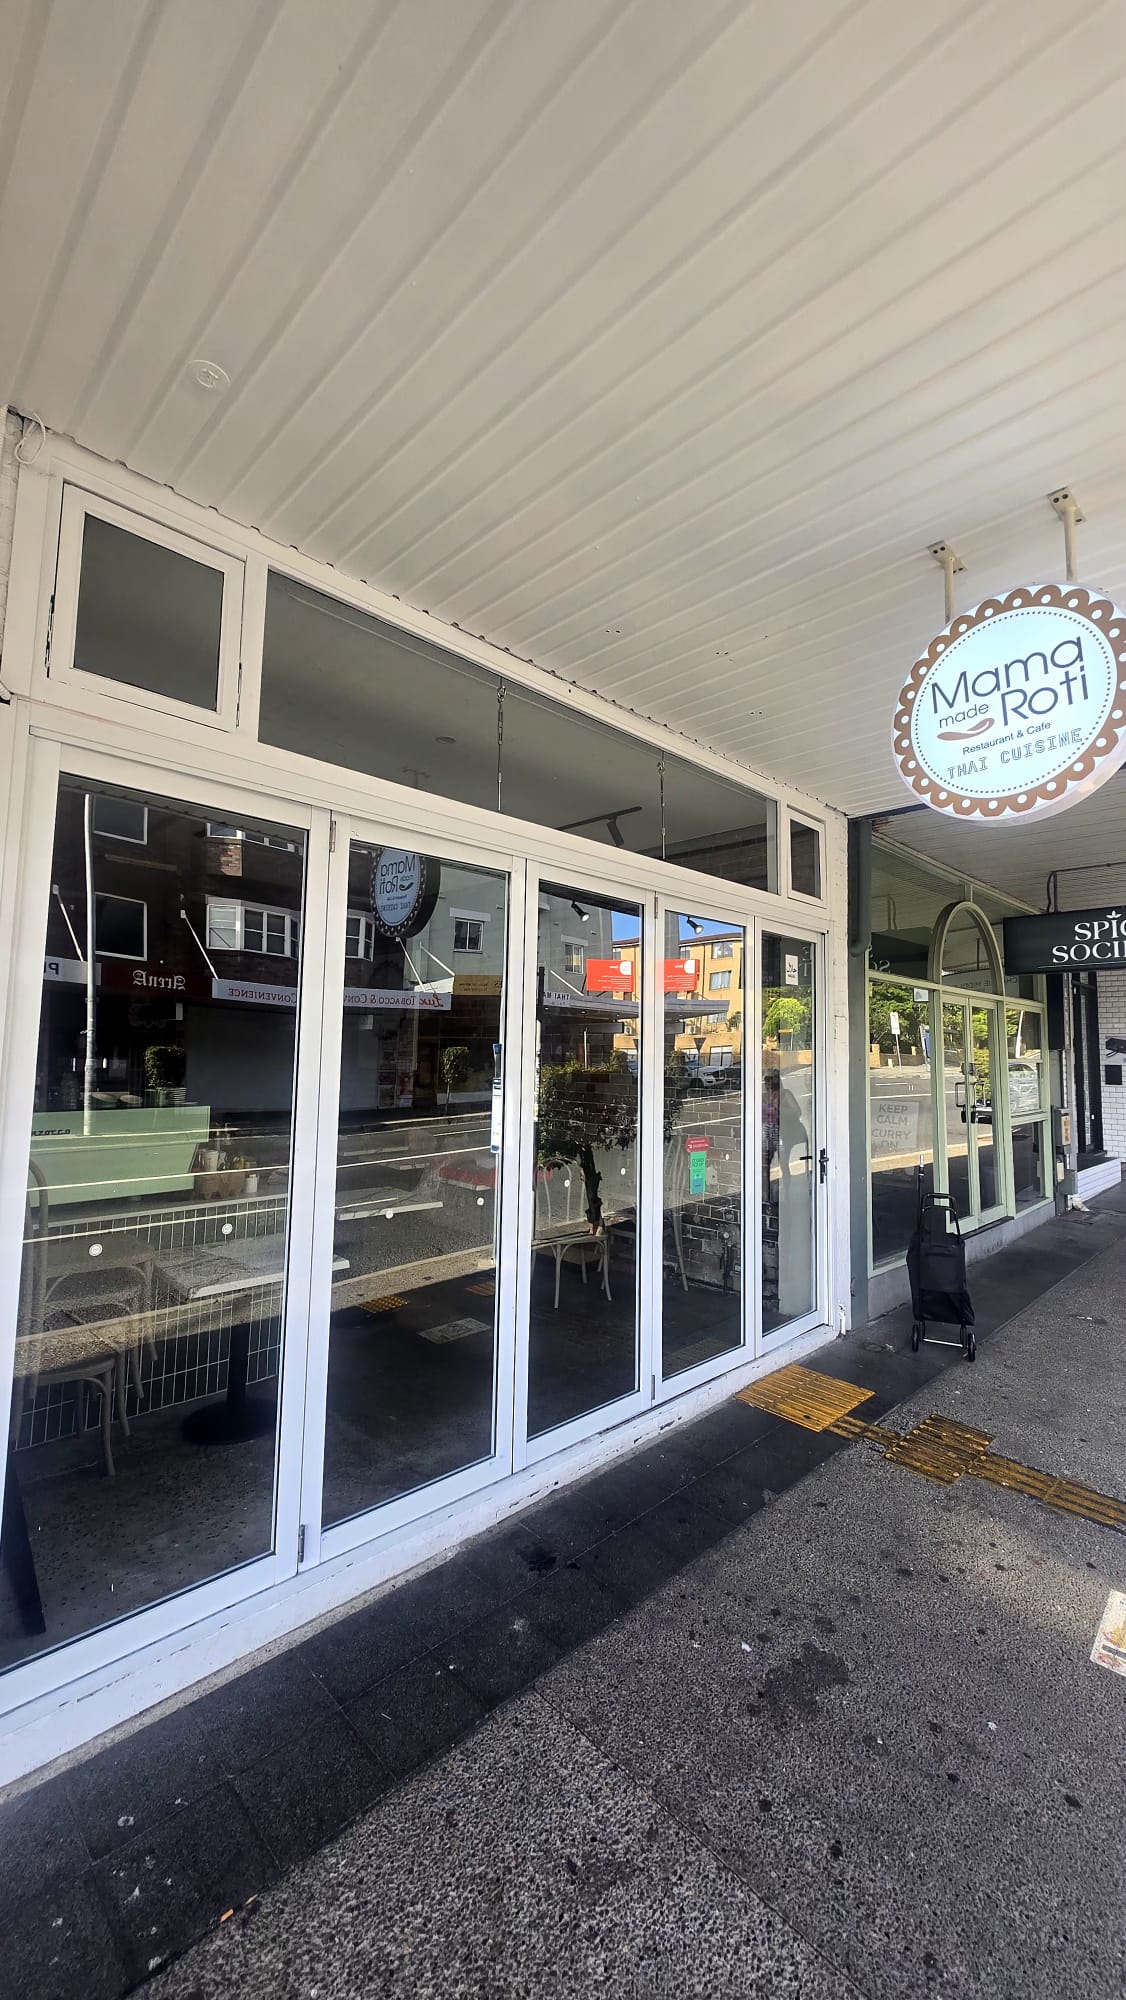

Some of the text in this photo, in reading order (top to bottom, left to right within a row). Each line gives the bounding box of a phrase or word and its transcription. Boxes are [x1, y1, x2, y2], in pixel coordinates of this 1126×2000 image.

[931, 636, 1082, 714] Mama
[939, 665, 1088, 728] made Roti
[947, 727, 1083, 779] THAI CUISINE
[962, 721, 1051, 755] Restaurant & Cafe
[877, 1115, 908, 1126] CALM
[878, 1104, 908, 1114] KEEP
[872, 1129, 912, 1140] CURRY
